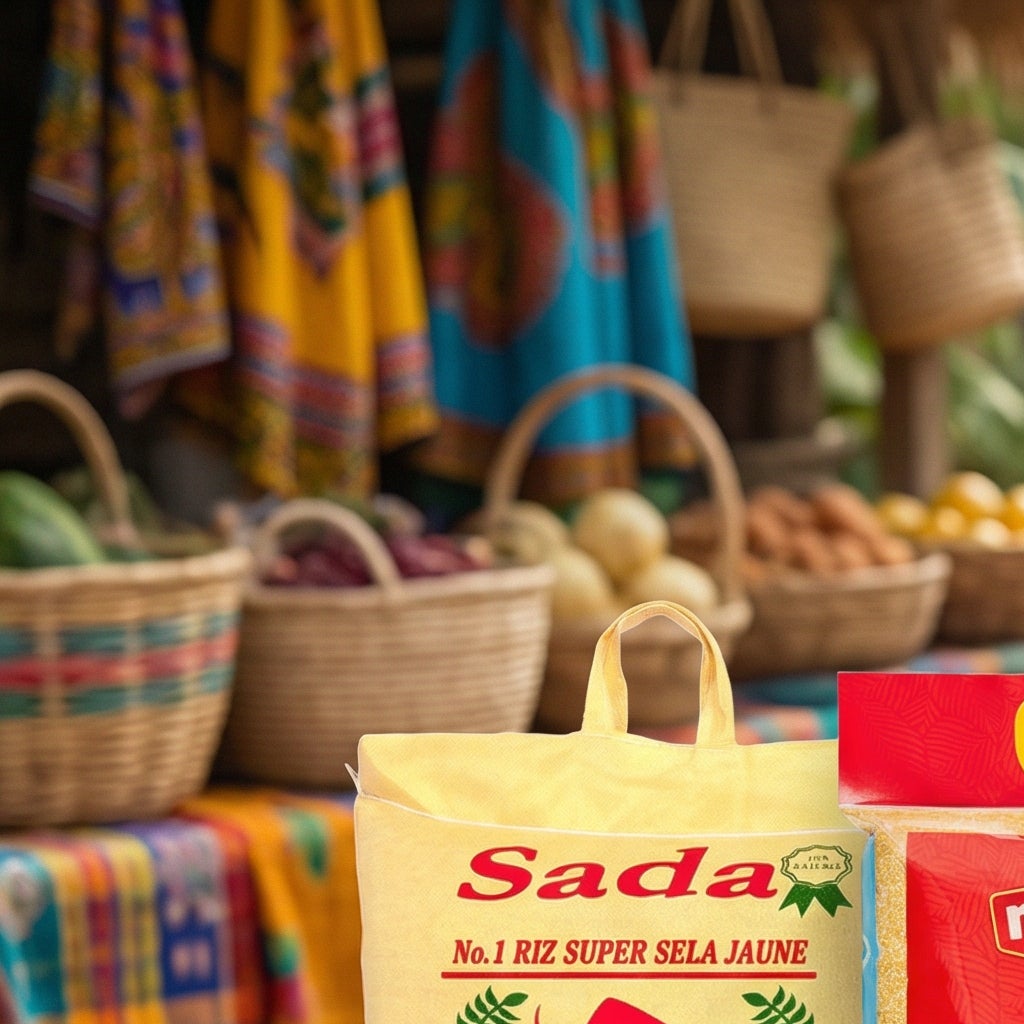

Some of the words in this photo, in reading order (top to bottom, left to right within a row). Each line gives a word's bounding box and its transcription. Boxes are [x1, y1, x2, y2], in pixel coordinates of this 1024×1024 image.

[457, 846, 777, 900] Sada
[513, 939, 558, 964] RIZ
[562, 939, 648, 964] SUPER
[654, 939, 717, 964] SELA
[723, 939, 809, 964] JAUNE
